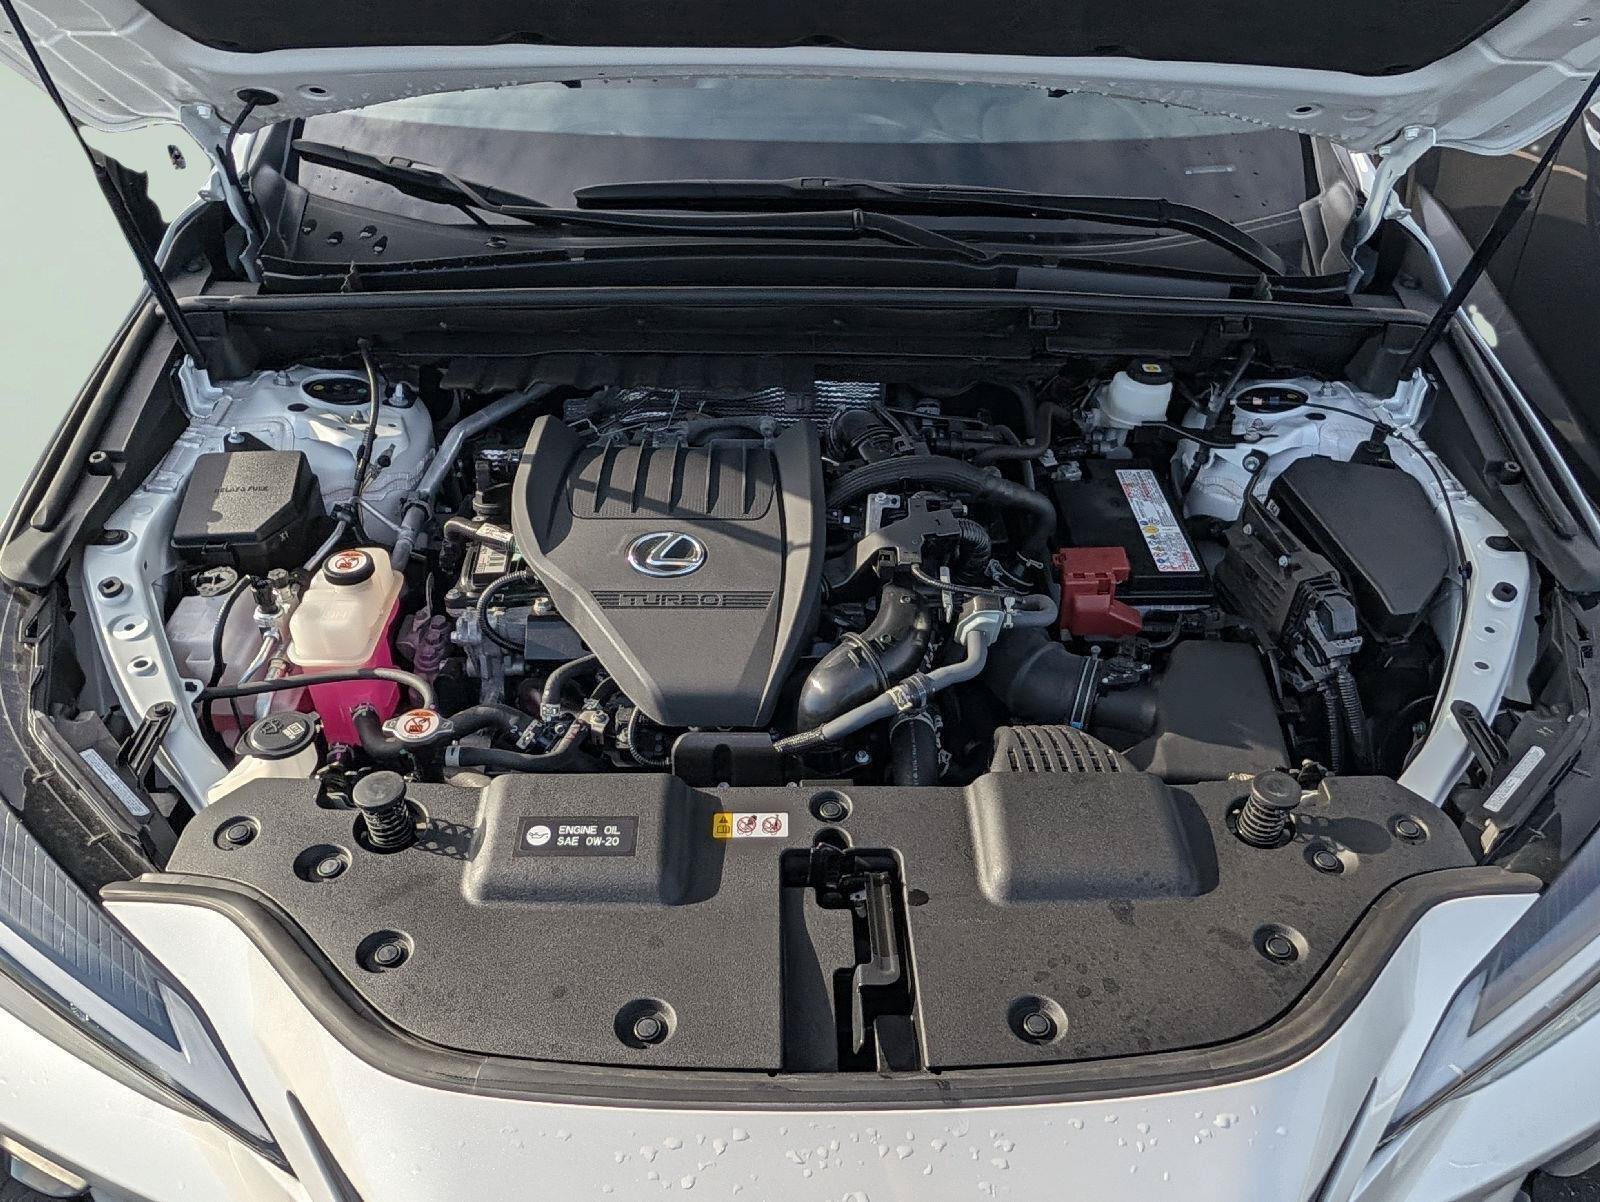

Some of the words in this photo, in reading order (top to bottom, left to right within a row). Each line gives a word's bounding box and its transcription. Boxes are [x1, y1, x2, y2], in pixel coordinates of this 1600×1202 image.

[621, 593, 720, 606] TURBO
[558, 825, 597, 835] ENGINE
[603, 825, 621, 835] OIL
[557, 836, 579, 846] SAE
[586, 836, 620, 846] 0W-20
